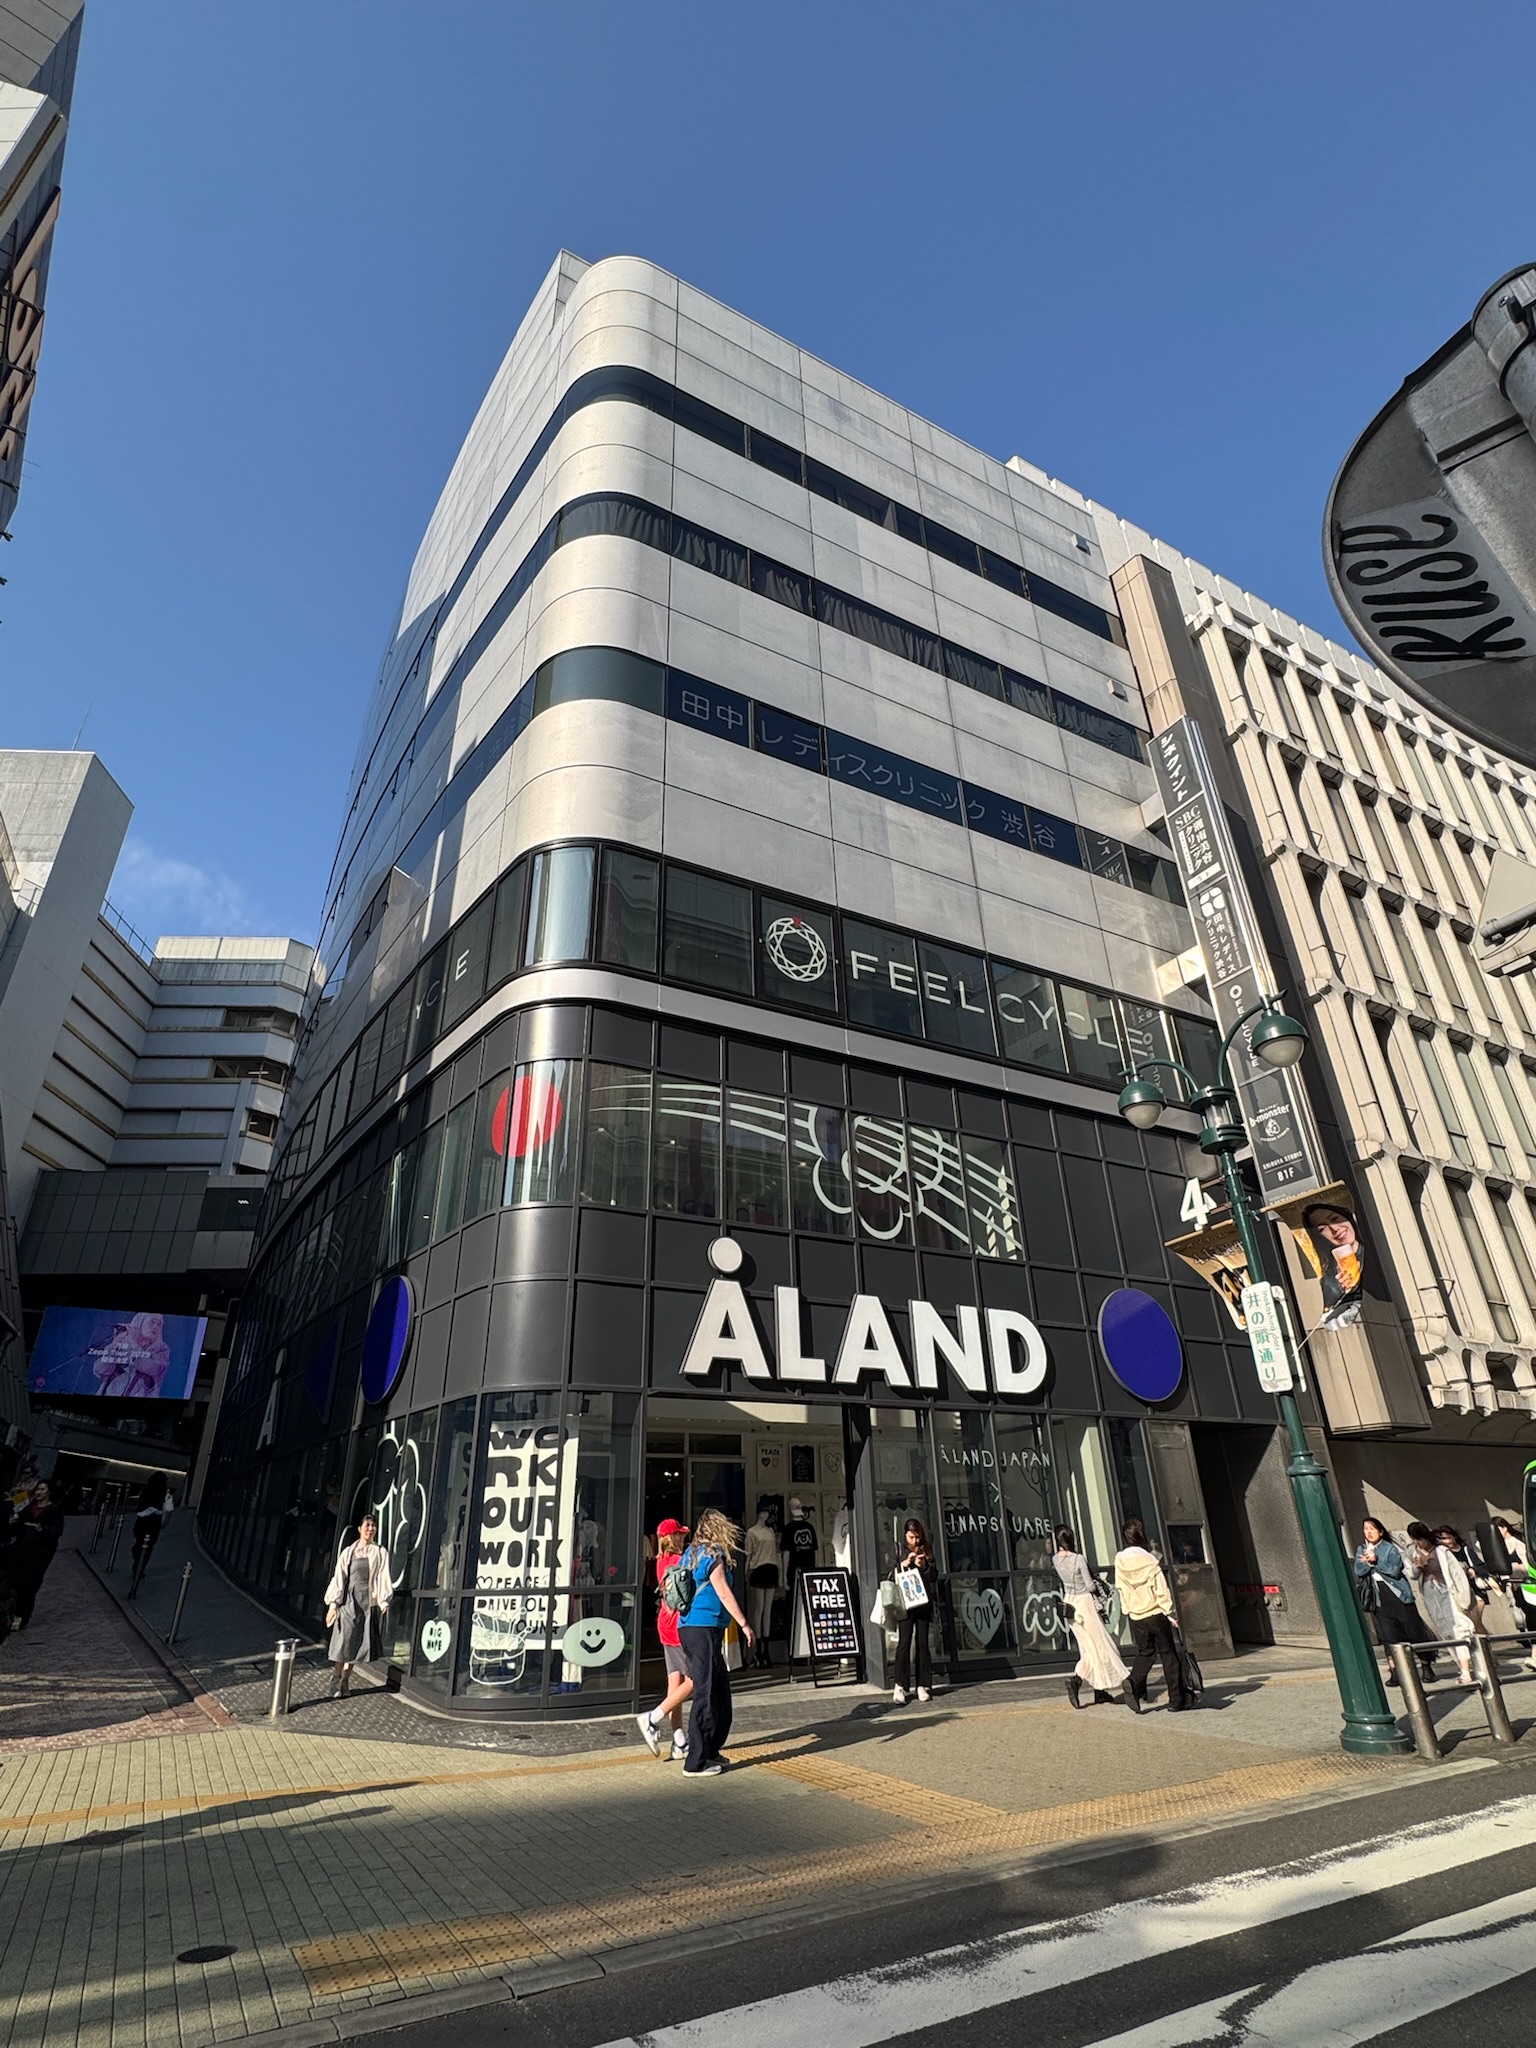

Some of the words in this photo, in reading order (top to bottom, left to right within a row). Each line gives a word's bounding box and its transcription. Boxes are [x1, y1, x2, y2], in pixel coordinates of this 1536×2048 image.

[681, 689, 986, 820] 田中レディスクリニック
[1001, 808, 1056, 849] 渋谷
[1175, 805, 1201, 828] SBC
[1185, 825, 1204, 870] クリニック
[1193, 818, 1213, 865] 湘南美容
[1205, 919, 1226, 979] クリニック渋谷
[1213, 912, 1237, 974] 田中レディス
[1249, 1104, 1290, 1127] b-monster
[1284, 1151, 1303, 1162] STUDIO
[1277, 1167, 1294, 1182] B1F
[679, 1236, 1047, 1394] ÅLAND
[1247, 1292, 1276, 1381] 井の頭通り
[1001, 1451, 1051, 1468] JAPAN
[478, 1538, 564, 1569] WORK
[496, 1576, 539, 1589] PEACE
[813, 1578, 840, 1593] TAX
[477, 1598, 517, 1611] DRIVE
[812, 1594, 847, 1609] FREE
